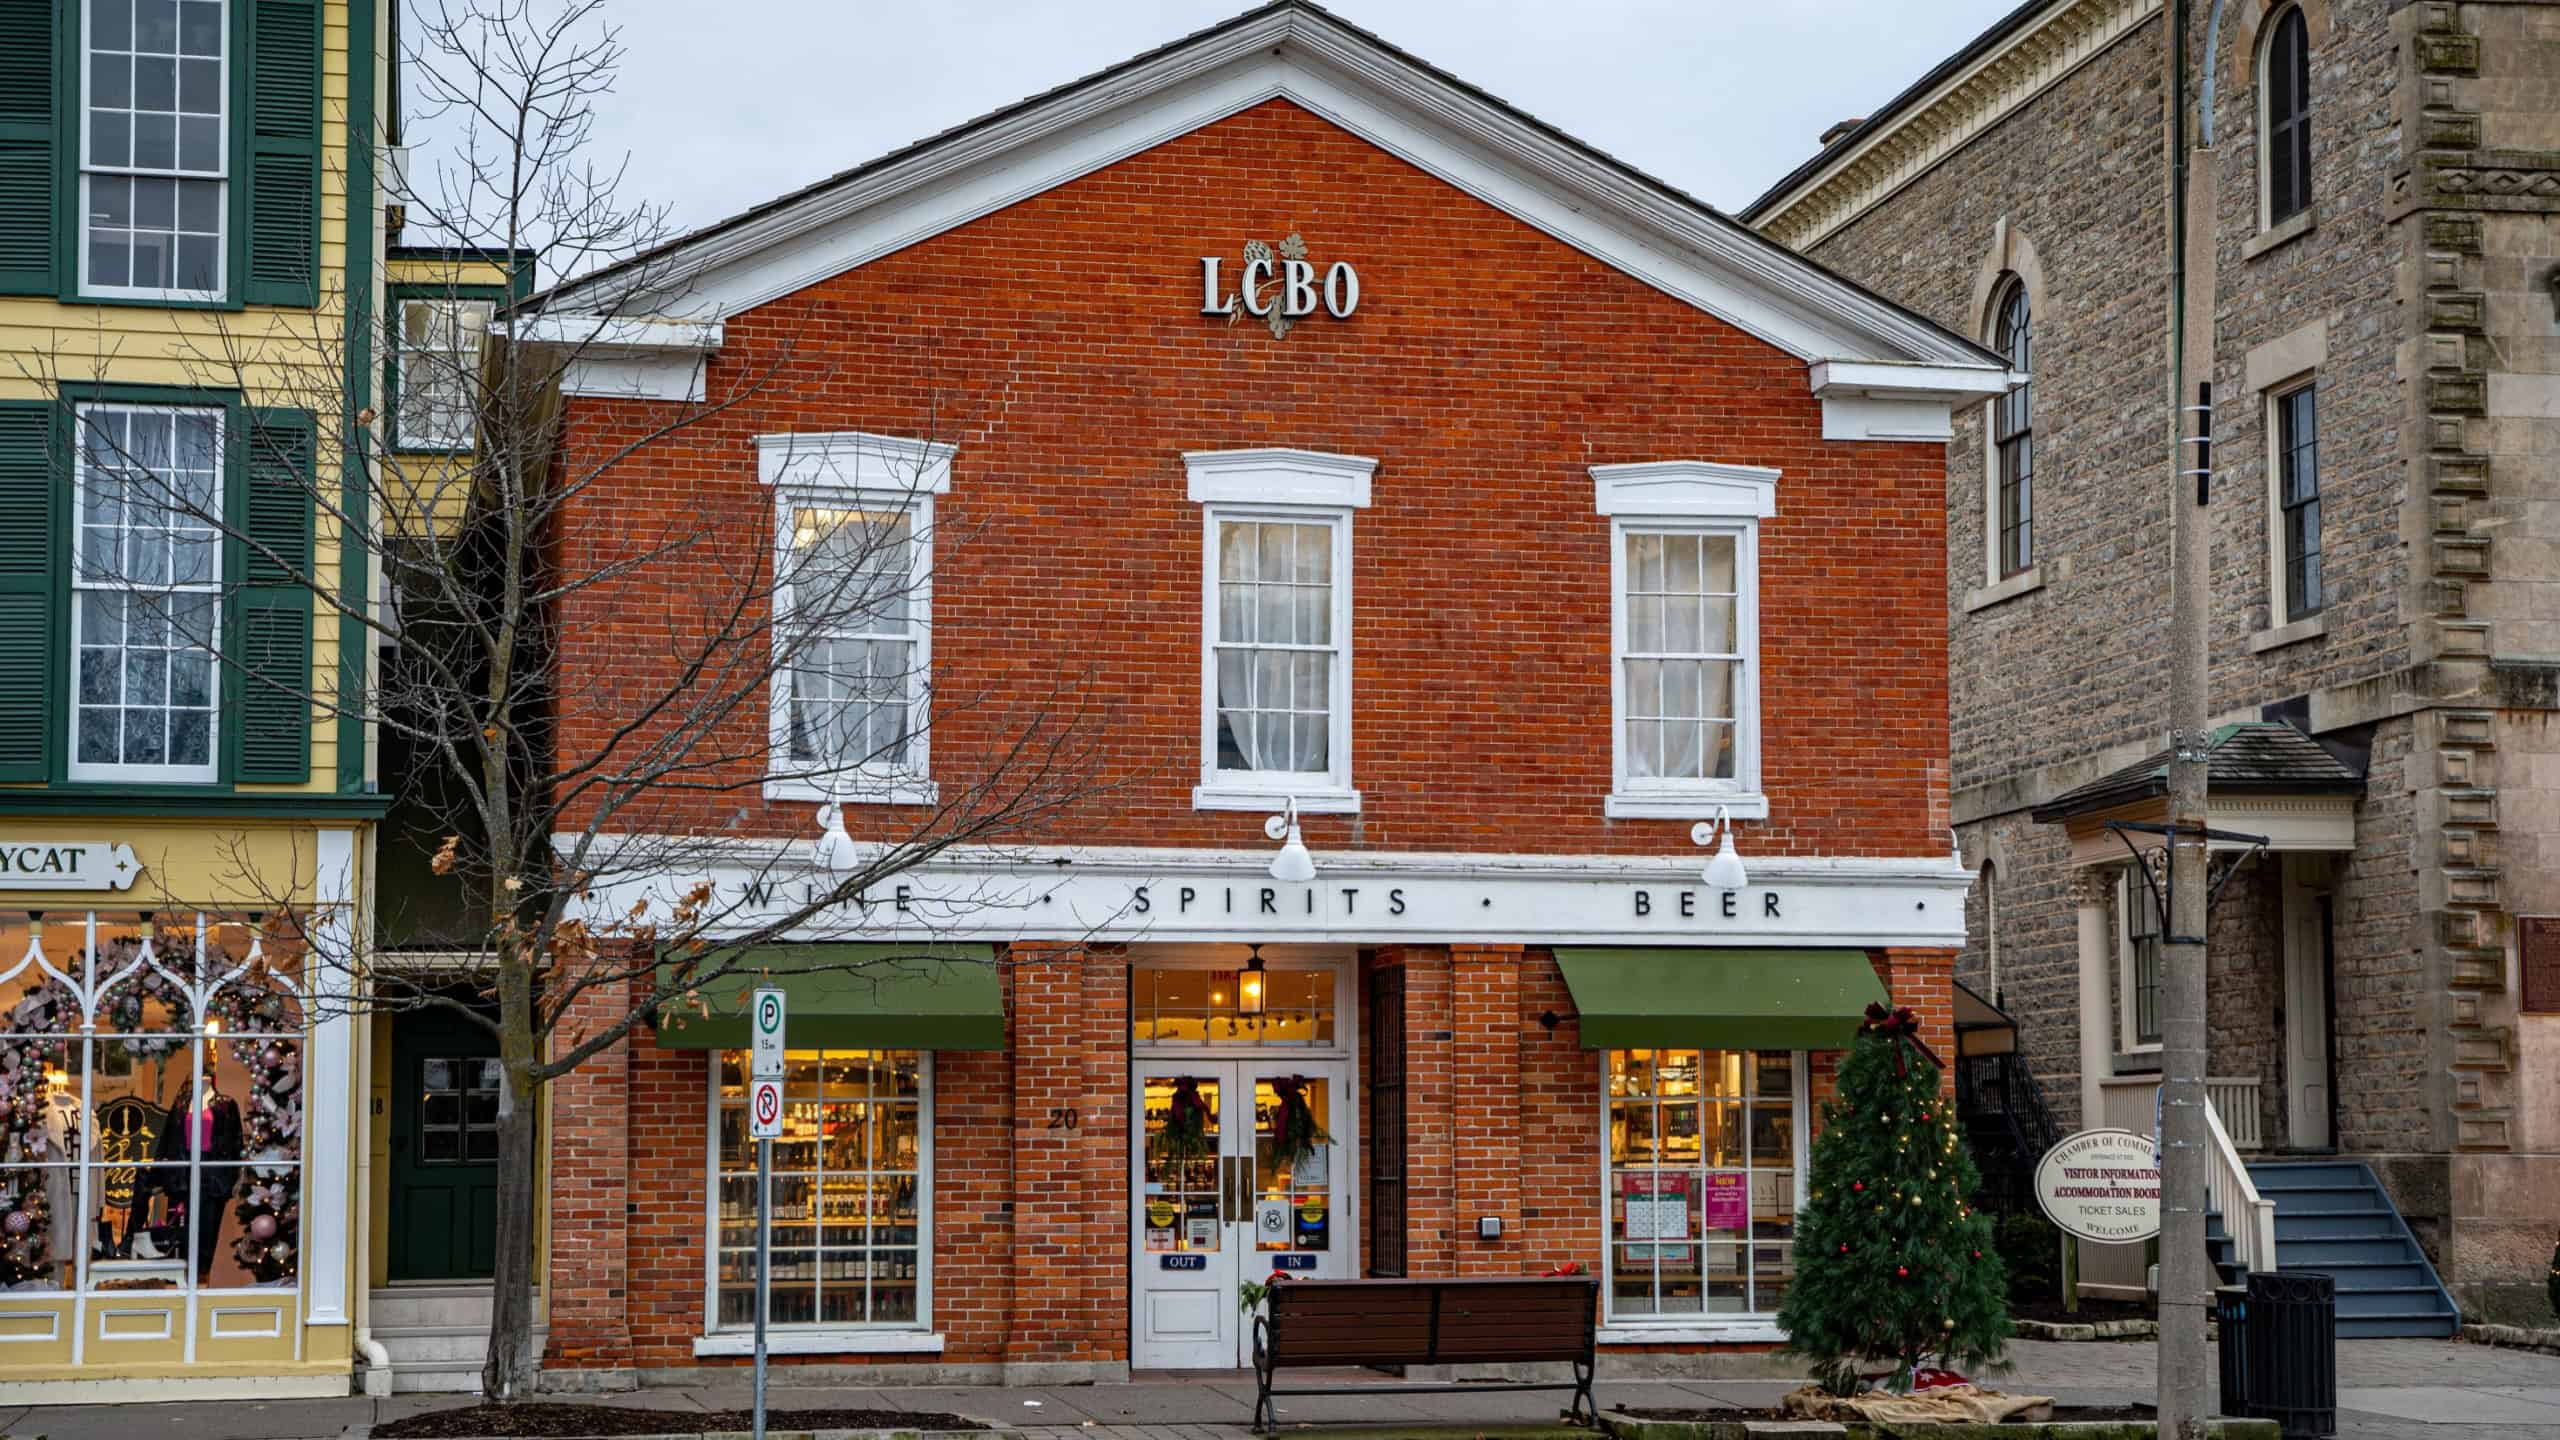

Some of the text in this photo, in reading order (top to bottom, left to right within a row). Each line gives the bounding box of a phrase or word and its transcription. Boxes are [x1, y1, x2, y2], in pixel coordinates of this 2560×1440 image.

[1200, 256, 1360, 319] LCBO
[0, 847, 86, 873] YCAT
[1134, 886, 1406, 915] SPIRITS
[1635, 890, 1781, 918] BEER
[1048, 1108, 1077, 1129] 20
[2055, 1138, 2099, 1165] CHAMBER
[2118, 1137, 2153, 1155] COMME
[2064, 1168, 2160, 1180] VISITOR INFORMATION
[2055, 1187, 2134, 1199] ACCOMMODATION
[2079, 1206, 2146, 1216] TICKET SALES
[2087, 1223, 2139, 1235] WELCOME
[1169, 1256, 1197, 1268] OUT
[1288, 1257, 1302, 1267] IN
